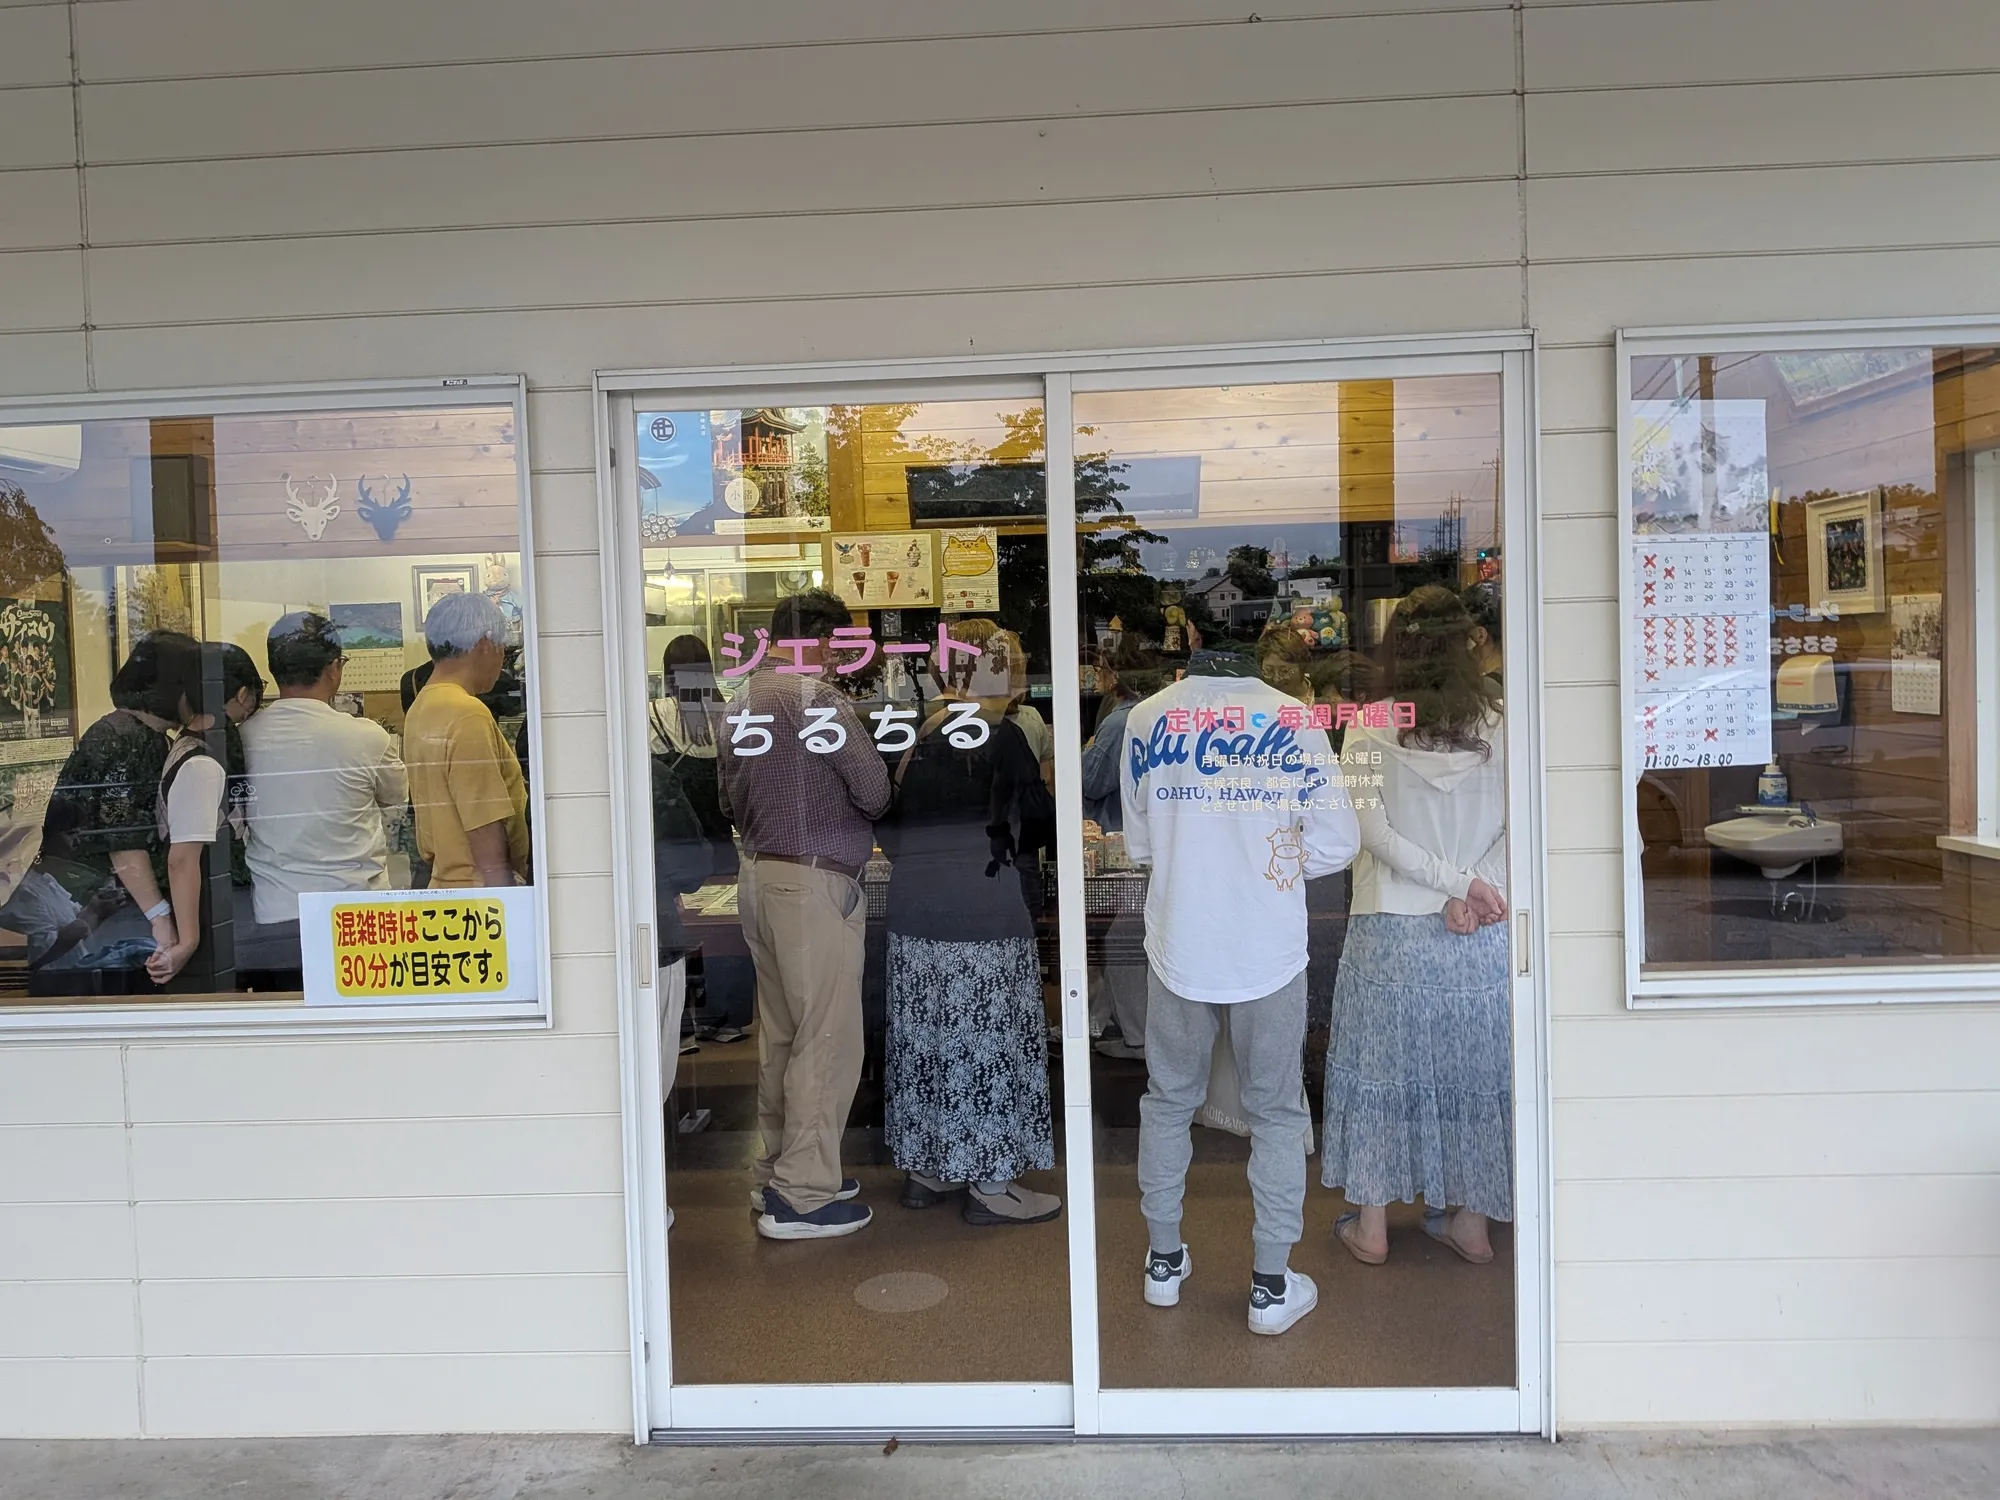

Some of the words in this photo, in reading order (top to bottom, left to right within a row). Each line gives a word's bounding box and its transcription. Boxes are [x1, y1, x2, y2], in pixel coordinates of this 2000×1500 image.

[721, 623, 983, 677] ジェラート
[726, 702, 990, 756] ちるちる
[1165, 706, 1245, 733] 定休日
[1277, 702, 1416, 730] 毎週月曜日
[1201, 752, 1382, 767] 月曜日が祝日の場合は火曜日
[335, 906, 502, 947] 混雑時はここから
[340, 949, 503, 989] 30分が目安です。
